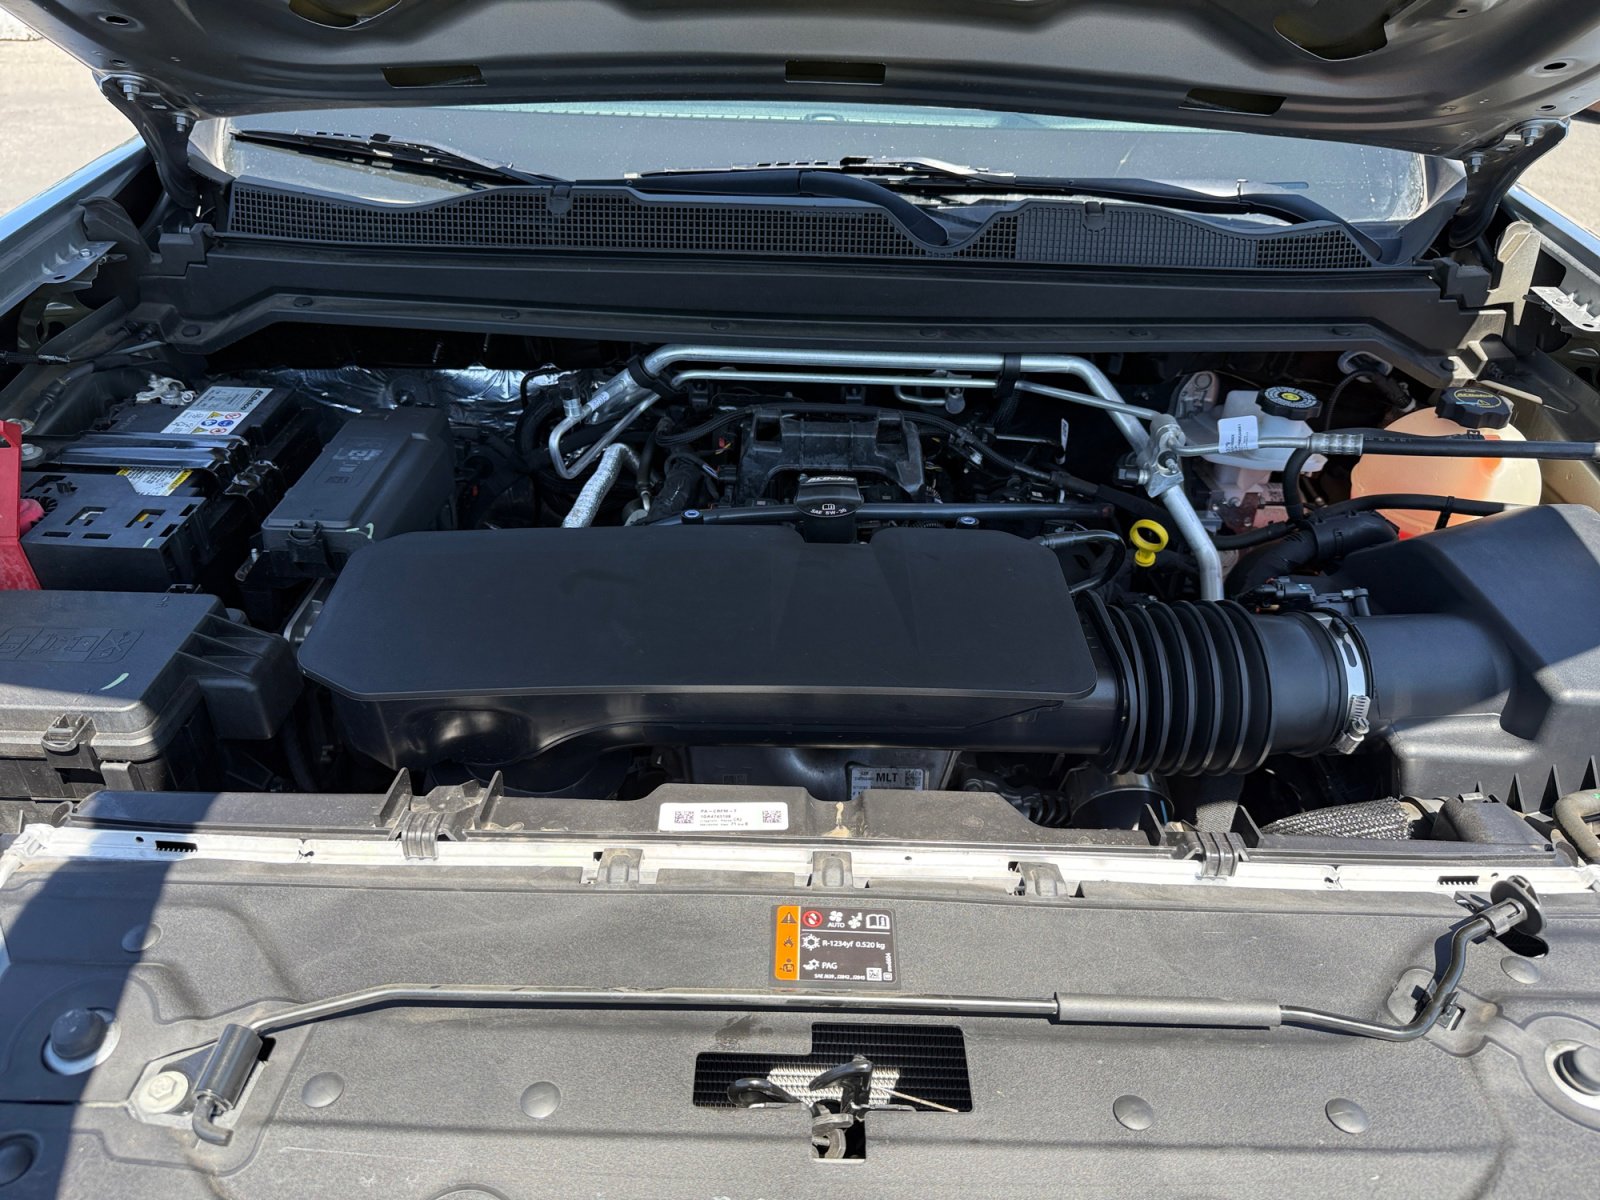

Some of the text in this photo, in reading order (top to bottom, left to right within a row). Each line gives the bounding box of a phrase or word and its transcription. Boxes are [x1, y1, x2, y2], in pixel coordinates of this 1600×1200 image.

[876, 772, 898, 782] MLT
[822, 940, 886, 950] R-1234yf 0.520 kg
[821, 961, 838, 970] PAG
